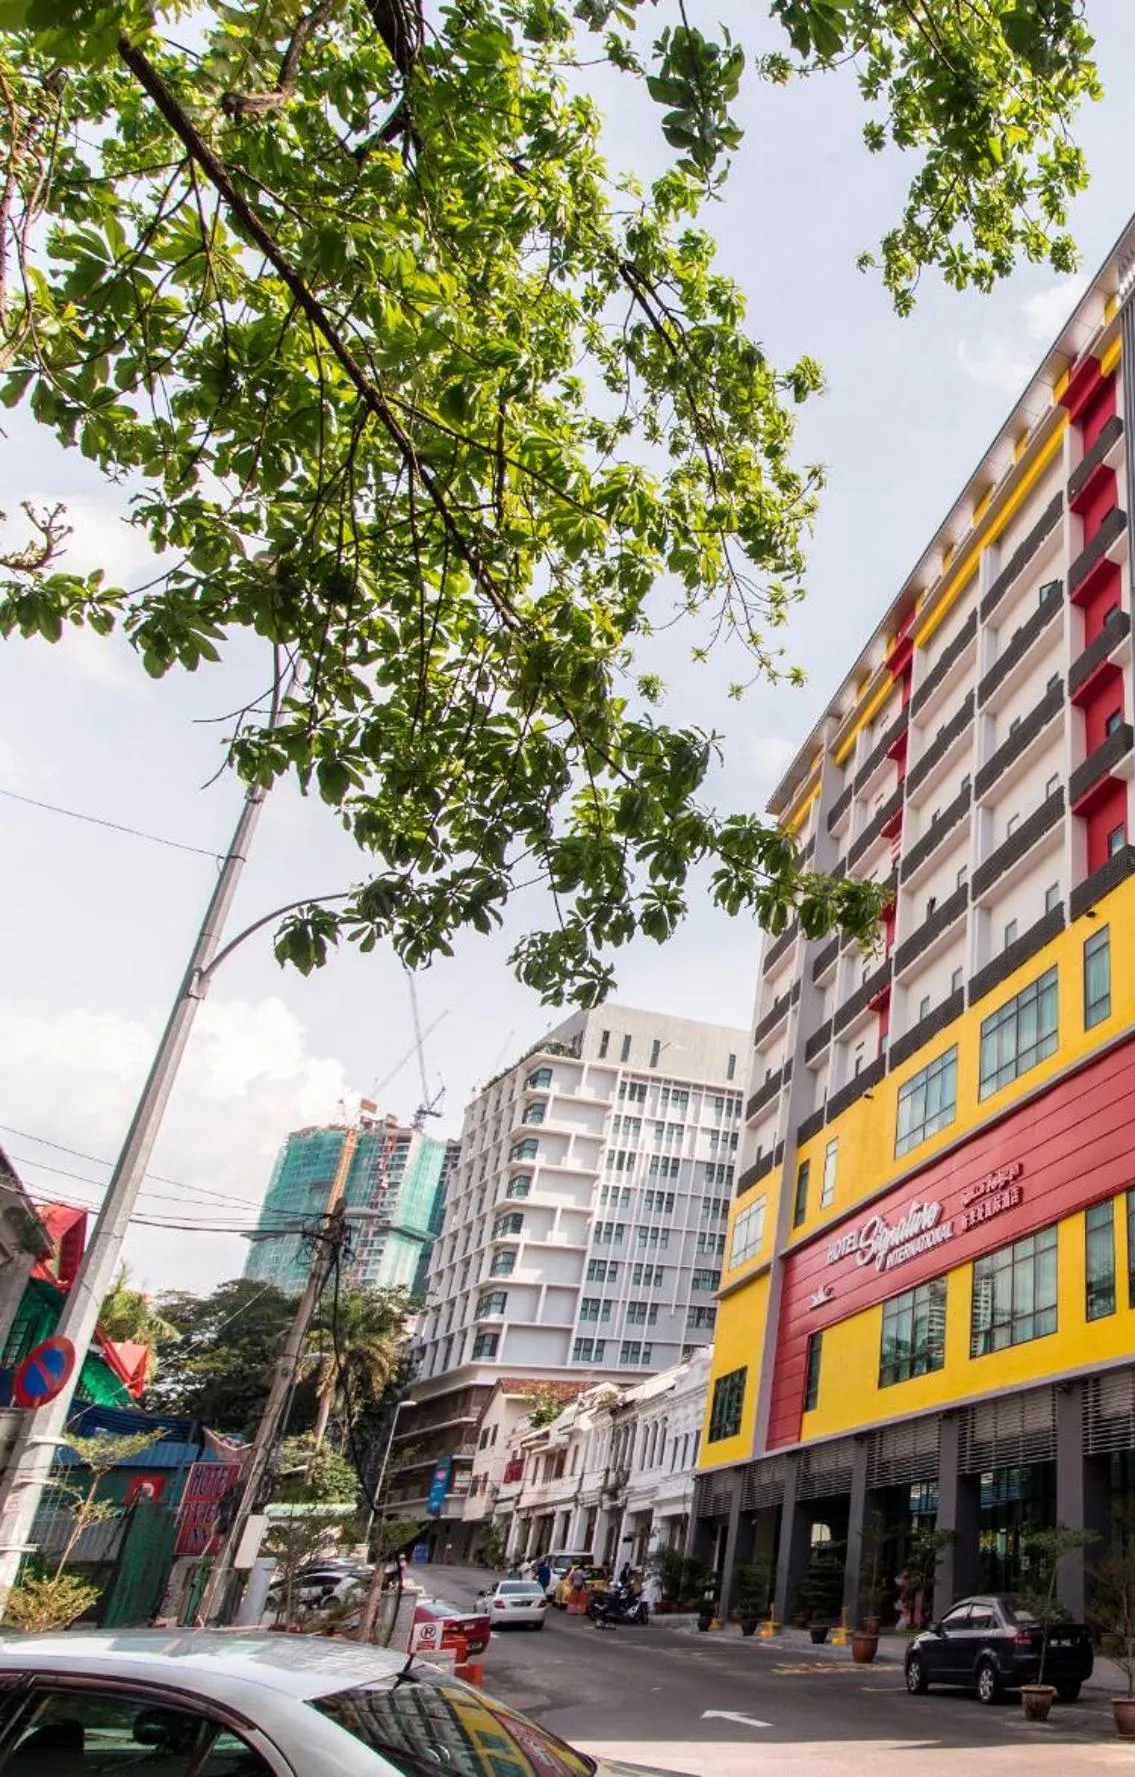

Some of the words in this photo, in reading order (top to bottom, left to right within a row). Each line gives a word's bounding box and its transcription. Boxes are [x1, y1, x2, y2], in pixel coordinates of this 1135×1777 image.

[827, 1230, 860, 1264] HOTEL
[855, 1201, 943, 1271] Signature
[885, 1222, 954, 1269] INTERNATIONAL
